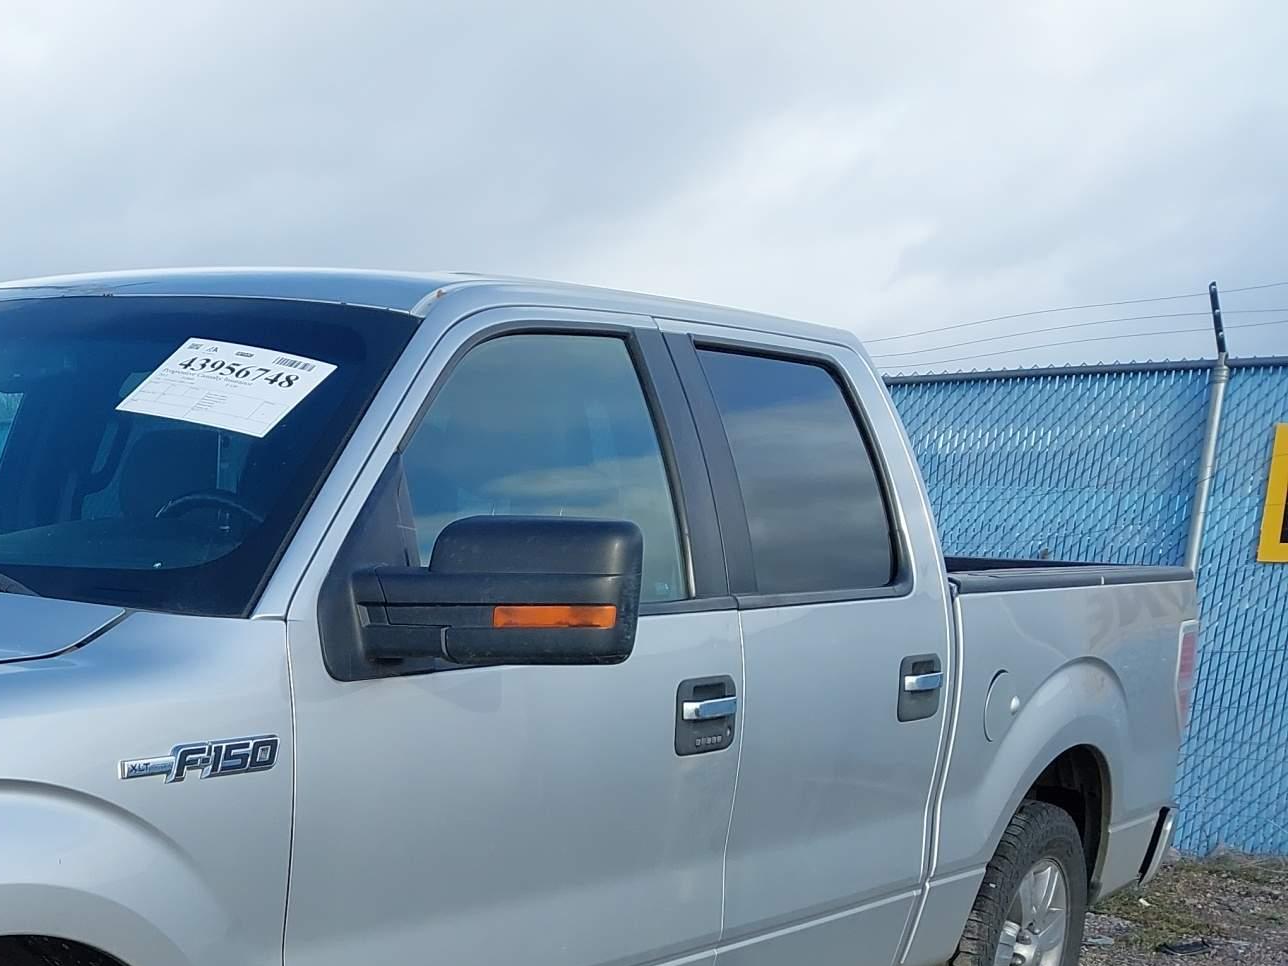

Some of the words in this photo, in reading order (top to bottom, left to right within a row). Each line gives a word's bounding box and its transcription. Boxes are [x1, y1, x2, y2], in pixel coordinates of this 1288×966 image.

[178, 356, 300, 389] 43956748
[129, 761, 151, 773] XLT
[167, 735, 280, 783] F-150
